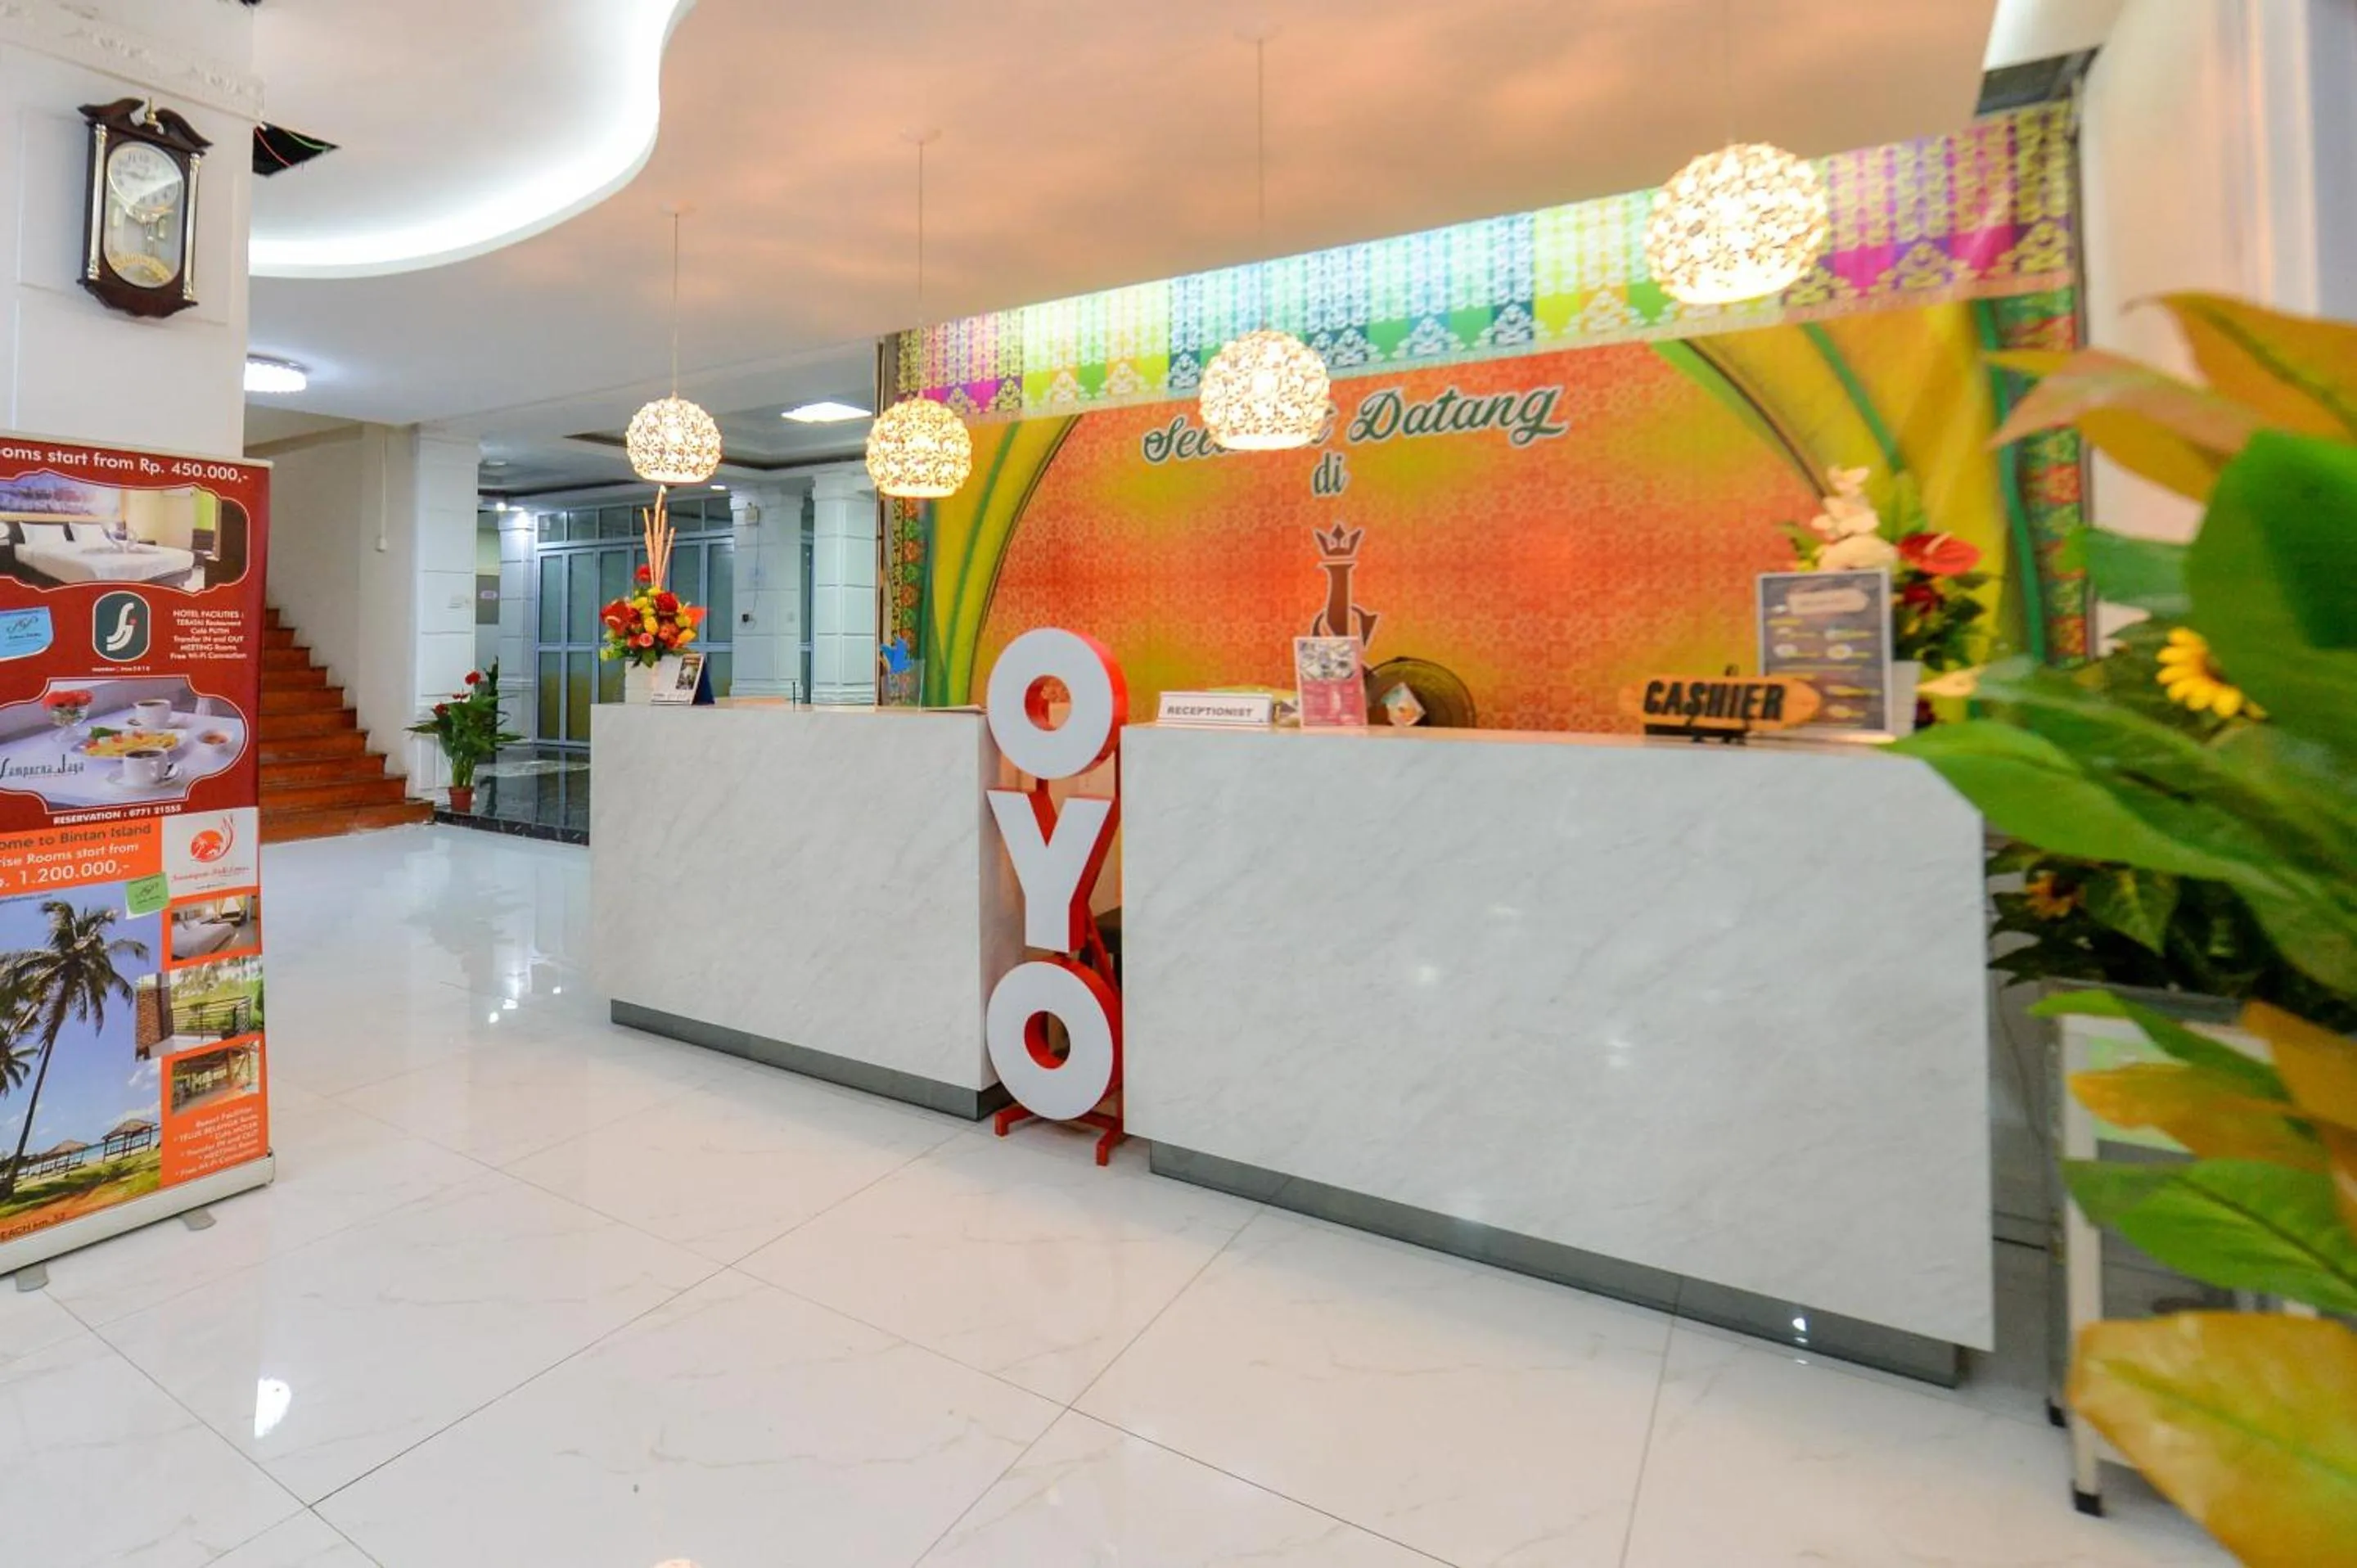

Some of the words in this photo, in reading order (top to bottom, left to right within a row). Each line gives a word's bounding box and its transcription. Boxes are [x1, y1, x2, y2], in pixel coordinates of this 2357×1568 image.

[1349, 387, 1566, 445] Datang
[0, 447, 42, 462] oms
[47, 449, 88, 466] start
[93, 452, 134, 470] from
[140, 457, 164, 477] Rp.
[1313, 451, 1346, 494] di
[1166, 705, 1253, 718] RECEPTIONIST
[1643, 679, 1786, 721] CASHIER
[53, 810, 121, 826] RESERVATION
[38, 836, 55, 846] to
[61, 829, 106, 844] Bintan
[111, 823, 151, 838] Island
[27, 850, 72, 865] Rooms
[77, 845, 105, 858] start
[109, 842, 139, 854] from
[987, 627, 1121, 1123] OYO
